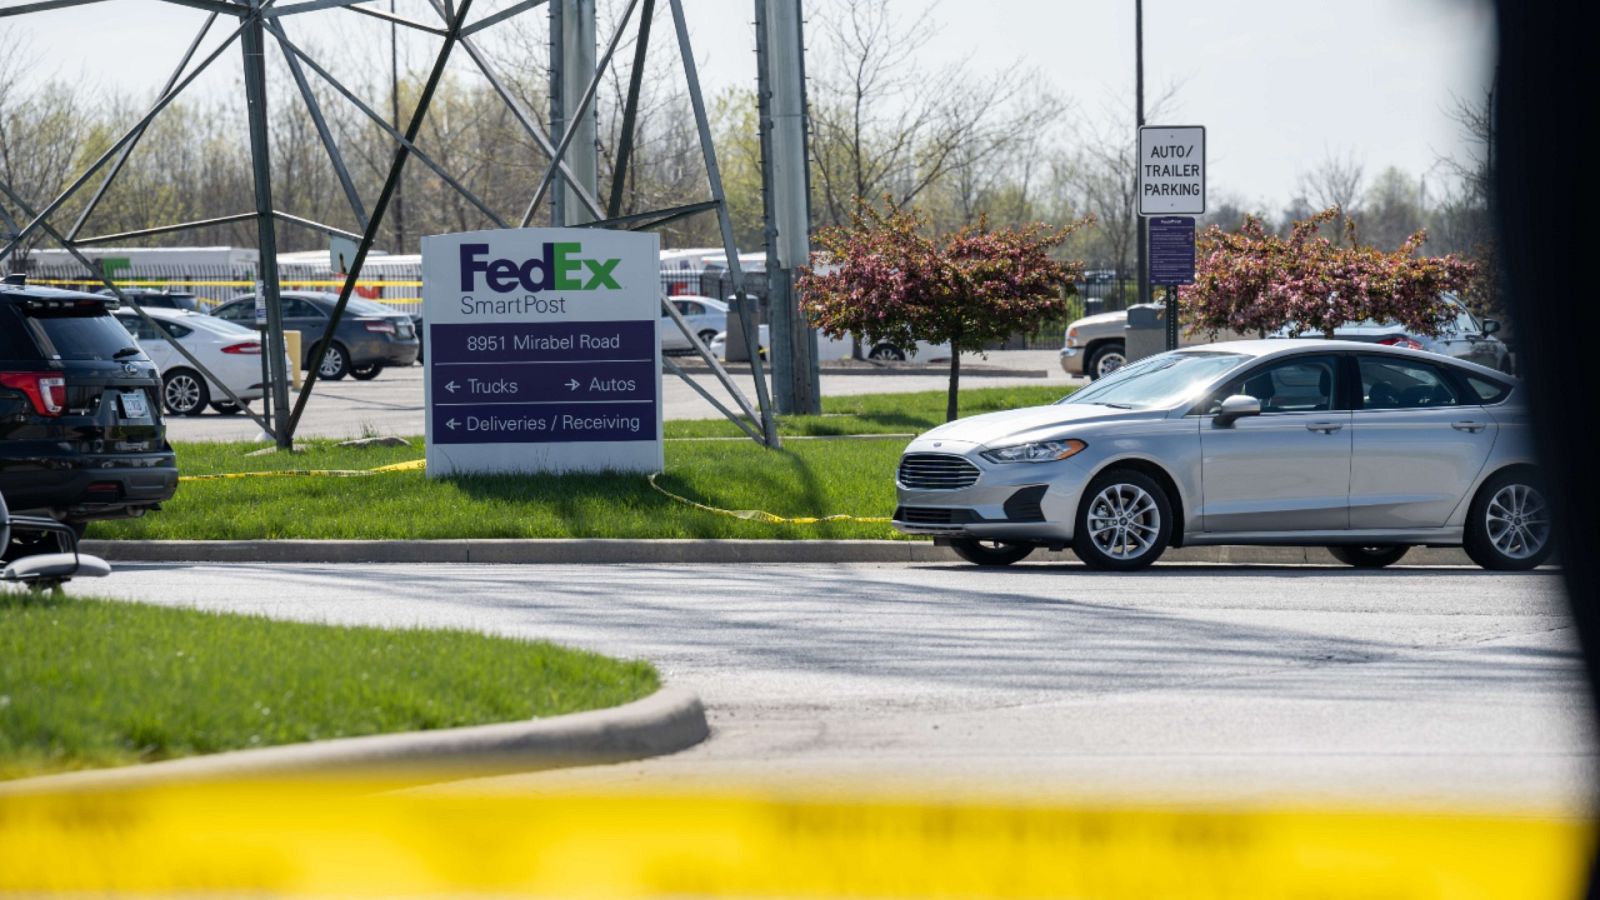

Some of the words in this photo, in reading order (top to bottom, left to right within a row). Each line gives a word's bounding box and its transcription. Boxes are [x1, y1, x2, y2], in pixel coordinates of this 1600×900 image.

[1150, 145, 1194, 159] AUTO/
[1144, 164, 1200, 178] TRAILER
[1144, 183, 1200, 197] PARKING
[460, 242, 622, 293] FedEx
[461, 295, 566, 315] SmartPost
[467, 335, 505, 351] 8951
[514, 334, 574, 350] Mirabel
[580, 333, 620, 349] Road
[468, 378, 519, 394] Trucks
[589, 376, 636, 391] Autos
[467, 415, 546, 431] Deliveries
[563, 414, 640, 432] Receiving
